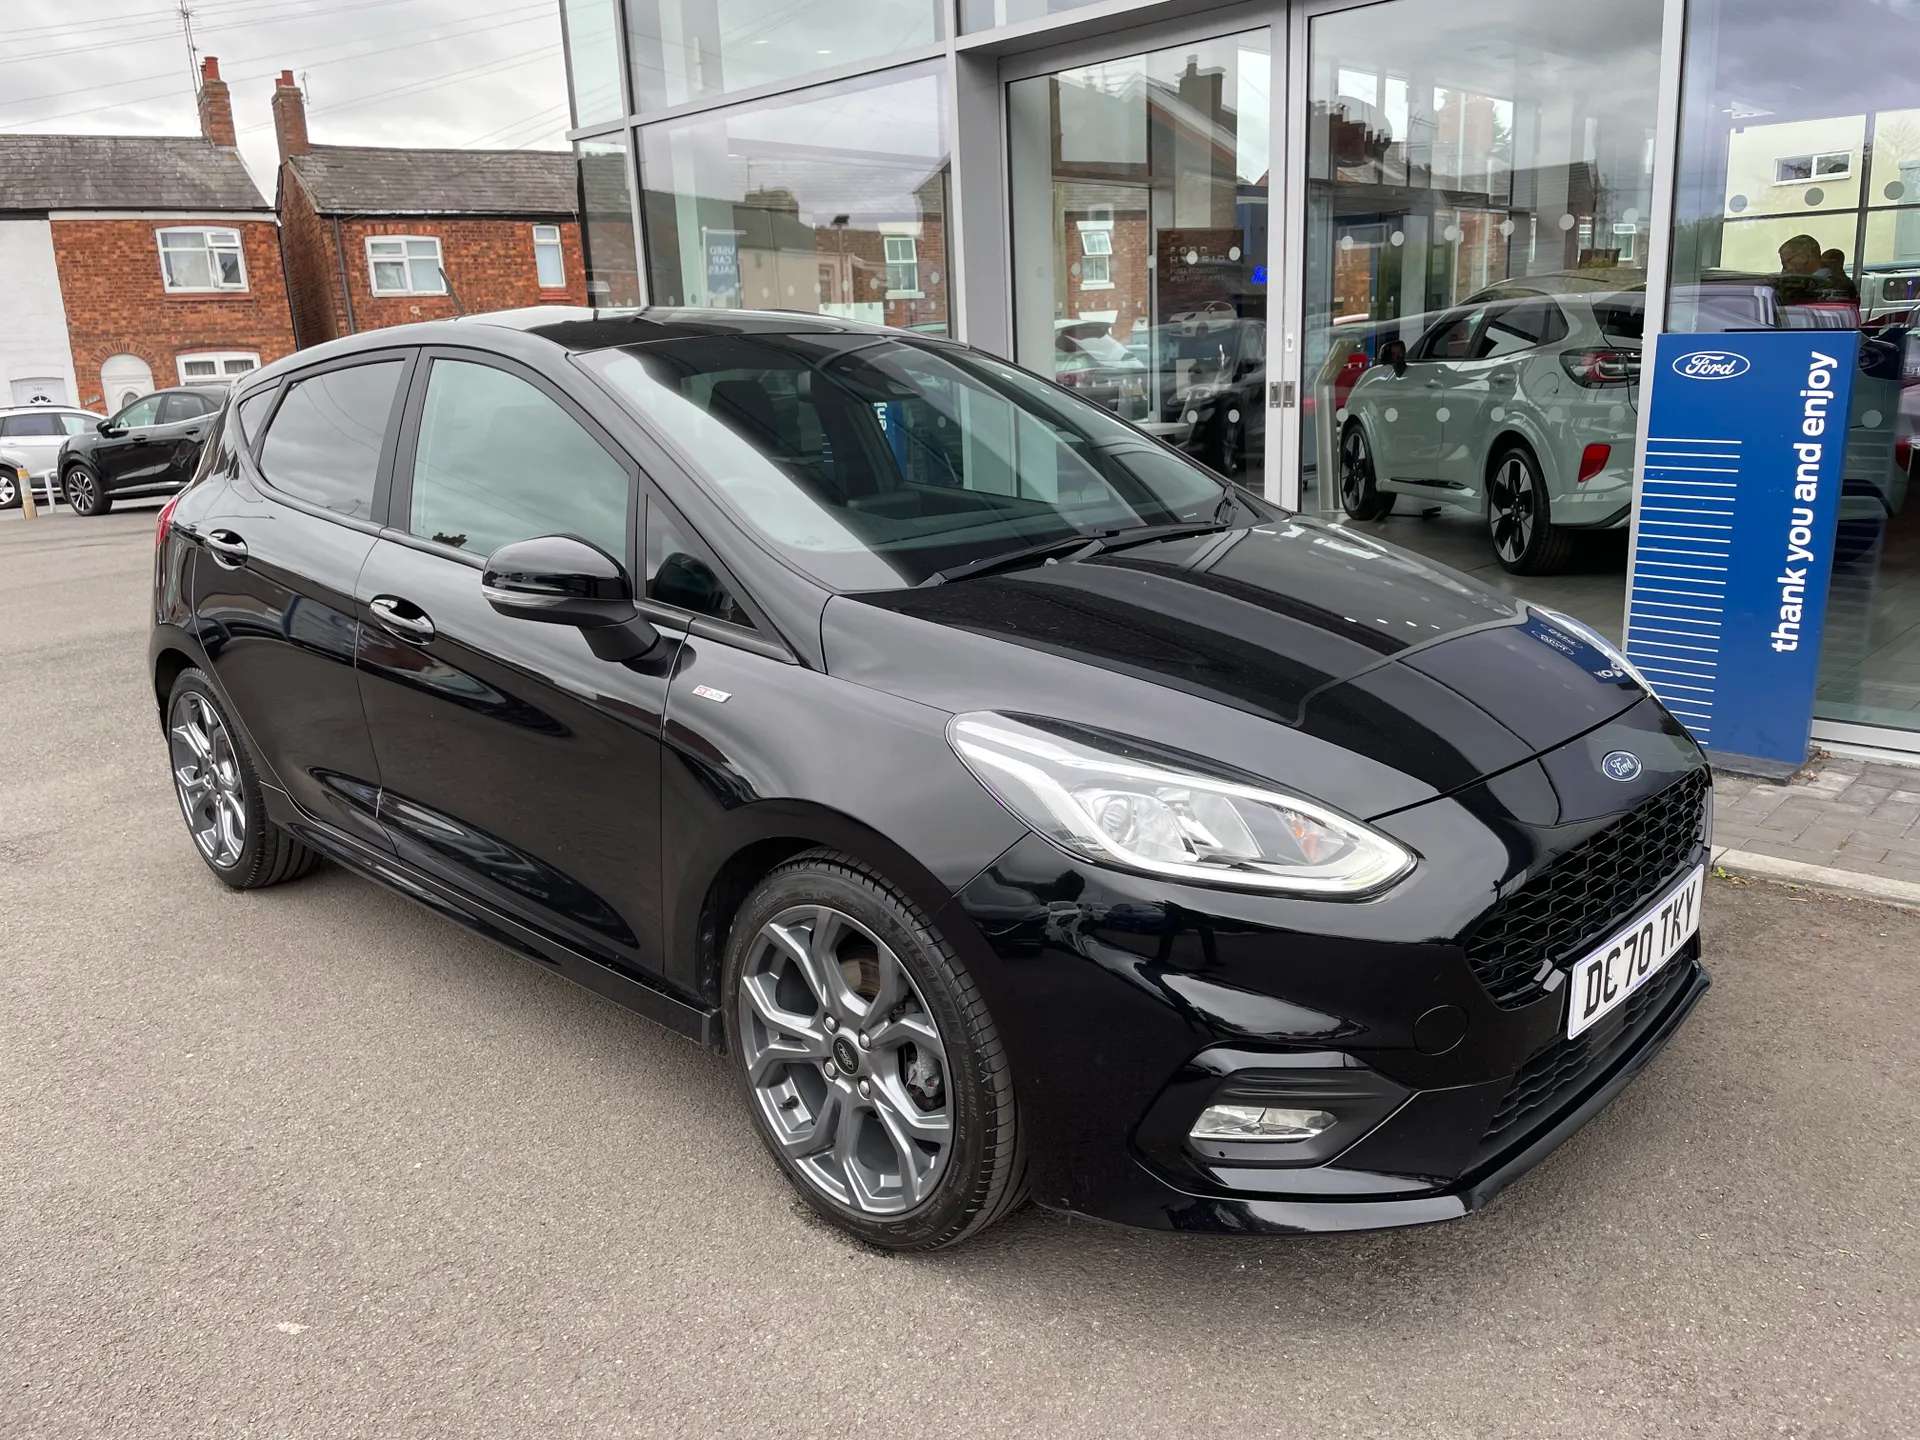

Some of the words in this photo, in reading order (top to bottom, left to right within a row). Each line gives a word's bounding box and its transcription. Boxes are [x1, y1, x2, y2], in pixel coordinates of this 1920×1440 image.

[1683, 350, 1738, 377] Ford
[1799, 350, 1838, 437] enjoy
[1793, 442, 1823, 502] and
[1787, 507, 1815, 562] you
[1770, 566, 1807, 653] thank
[1583, 921, 1653, 1020] DC70
[1661, 880, 1696, 957] TKY
